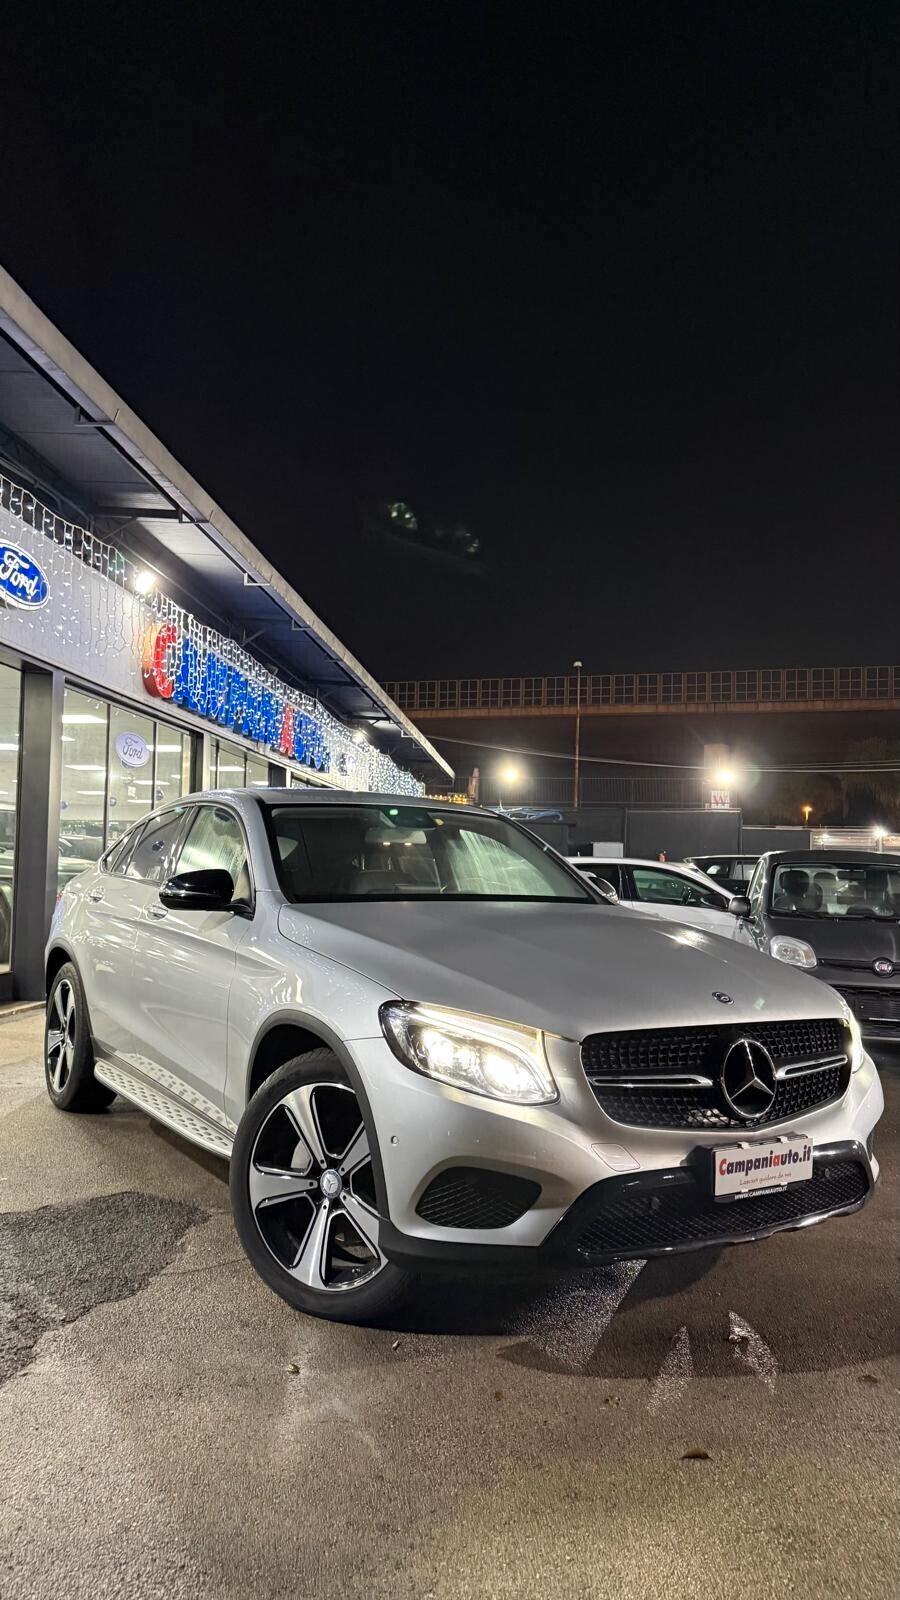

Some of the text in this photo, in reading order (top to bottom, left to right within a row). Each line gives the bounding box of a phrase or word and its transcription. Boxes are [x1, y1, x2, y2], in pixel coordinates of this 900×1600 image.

[0, 551, 40, 597] Ford
[122, 736, 144, 760] Ford
[719, 1145, 811, 1176] Campaniauto.it
